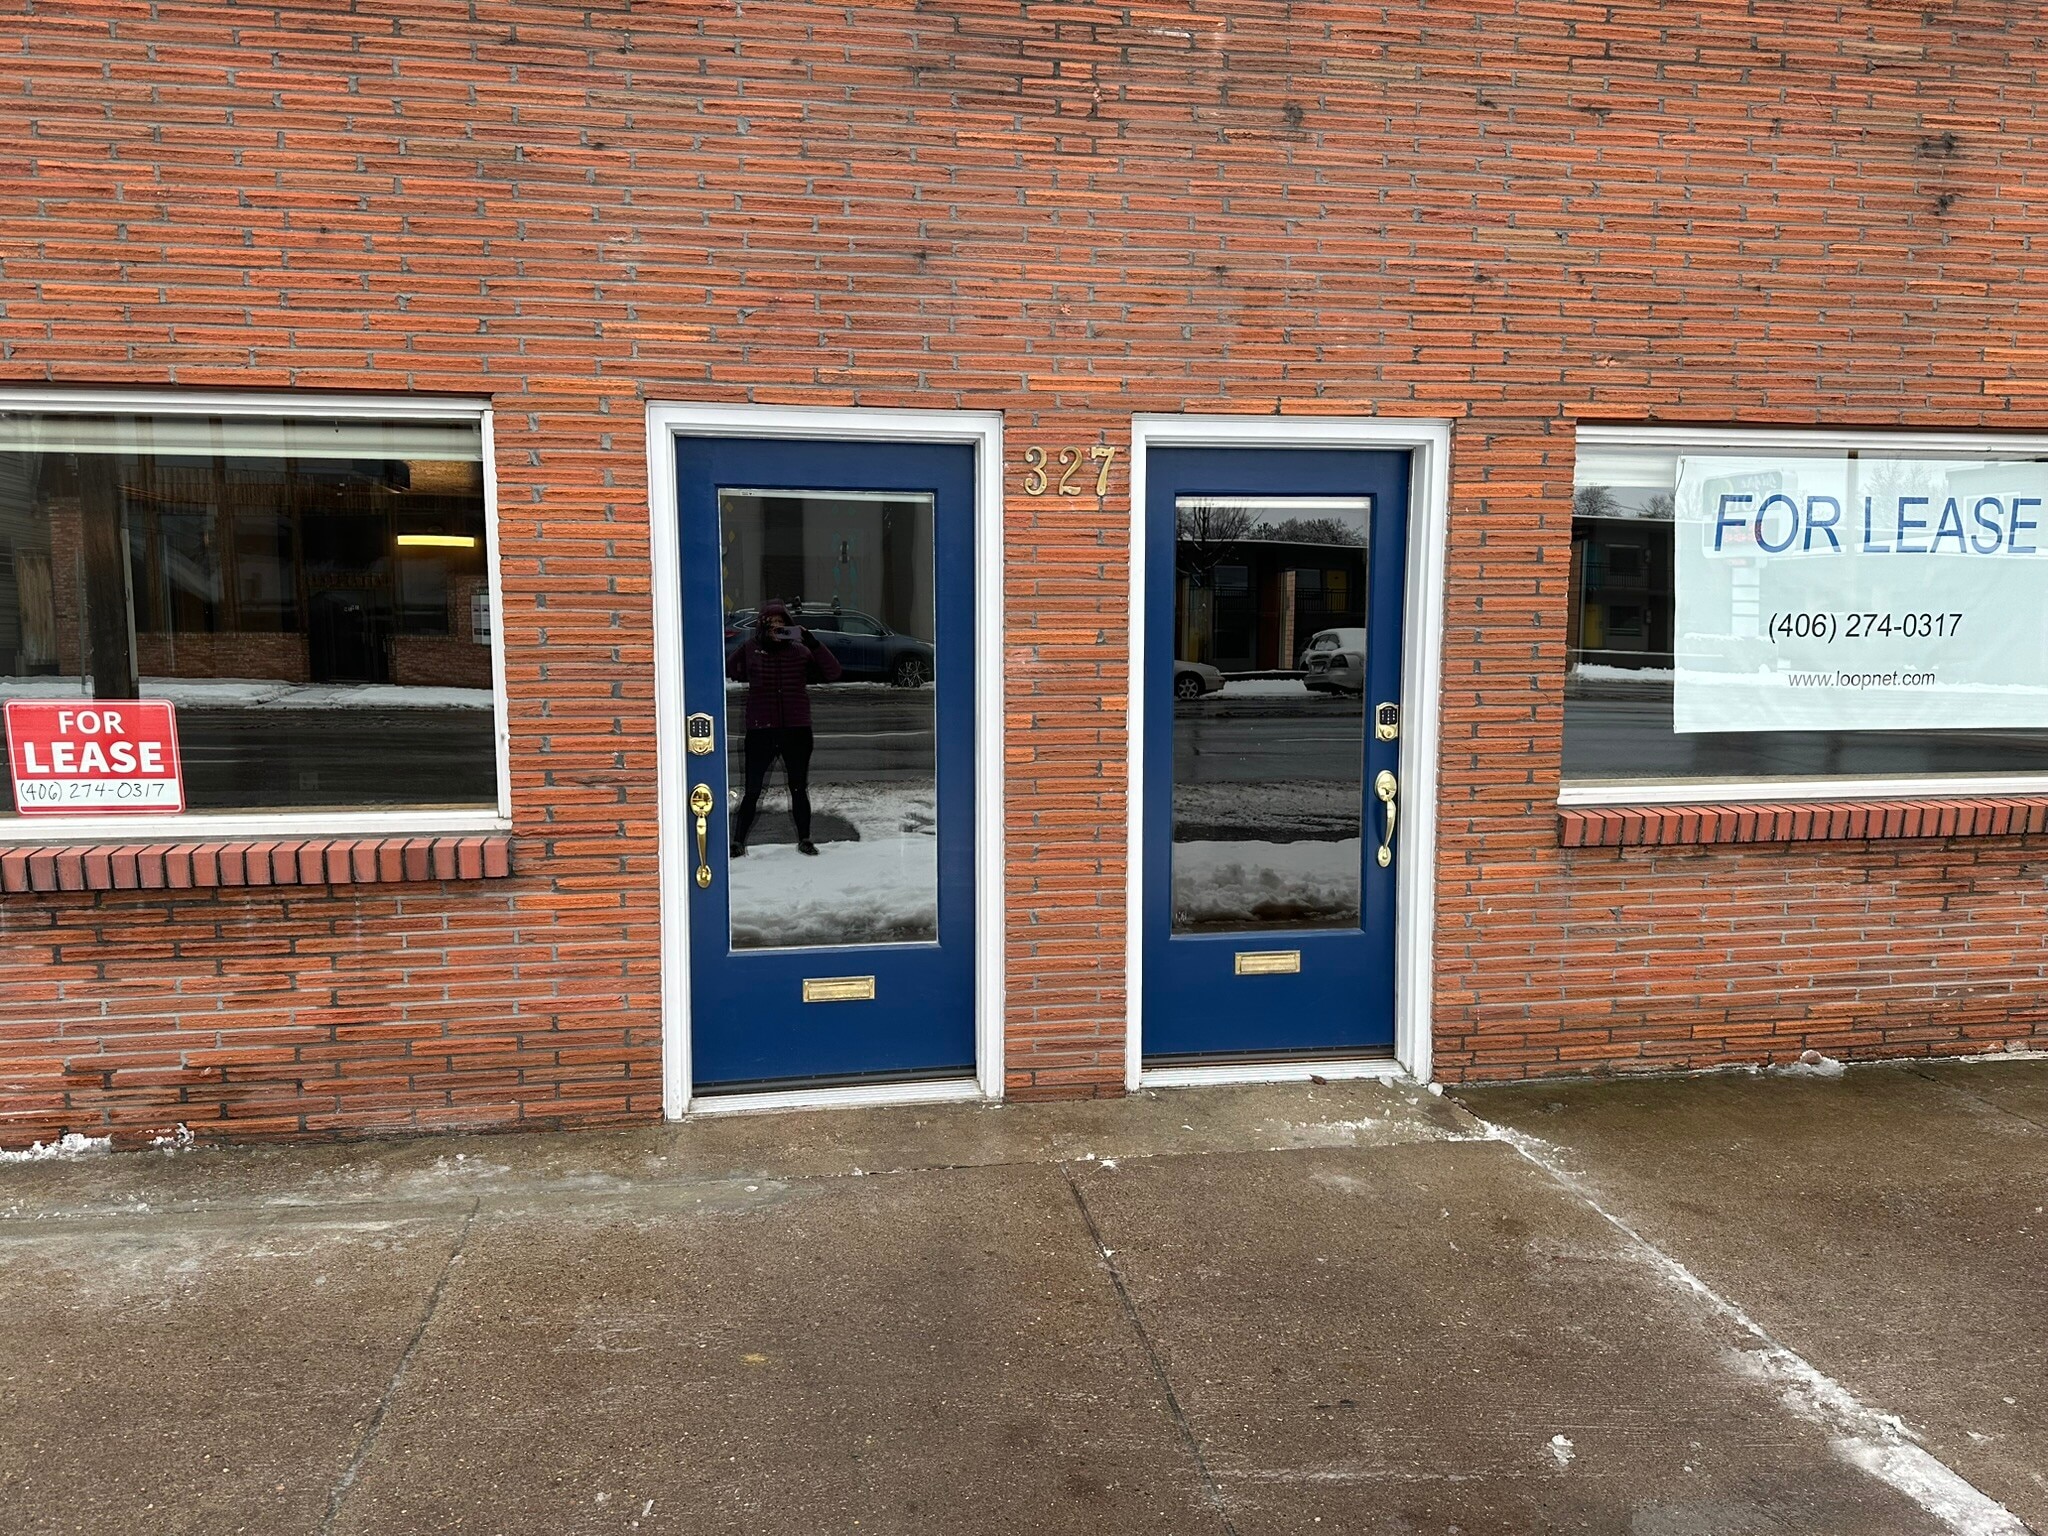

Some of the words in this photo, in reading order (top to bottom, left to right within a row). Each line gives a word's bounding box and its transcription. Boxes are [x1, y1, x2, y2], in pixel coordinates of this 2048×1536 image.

[1025, 446, 1115, 496] 327
[1713, 493, 1842, 553] FOR
[1862, 496, 2042, 555] LEASE
[1768, 613, 1837, 643] (406)
[1845, 613, 1963, 638] 274-0317
[1787, 670, 1936, 690] www.loopnet.com
[58, 710, 125, 734] FOR
[23, 741, 165, 774] LEASE
[20, 782, 63, 802] (406)
[69, 782, 165, 799] 274-0317
